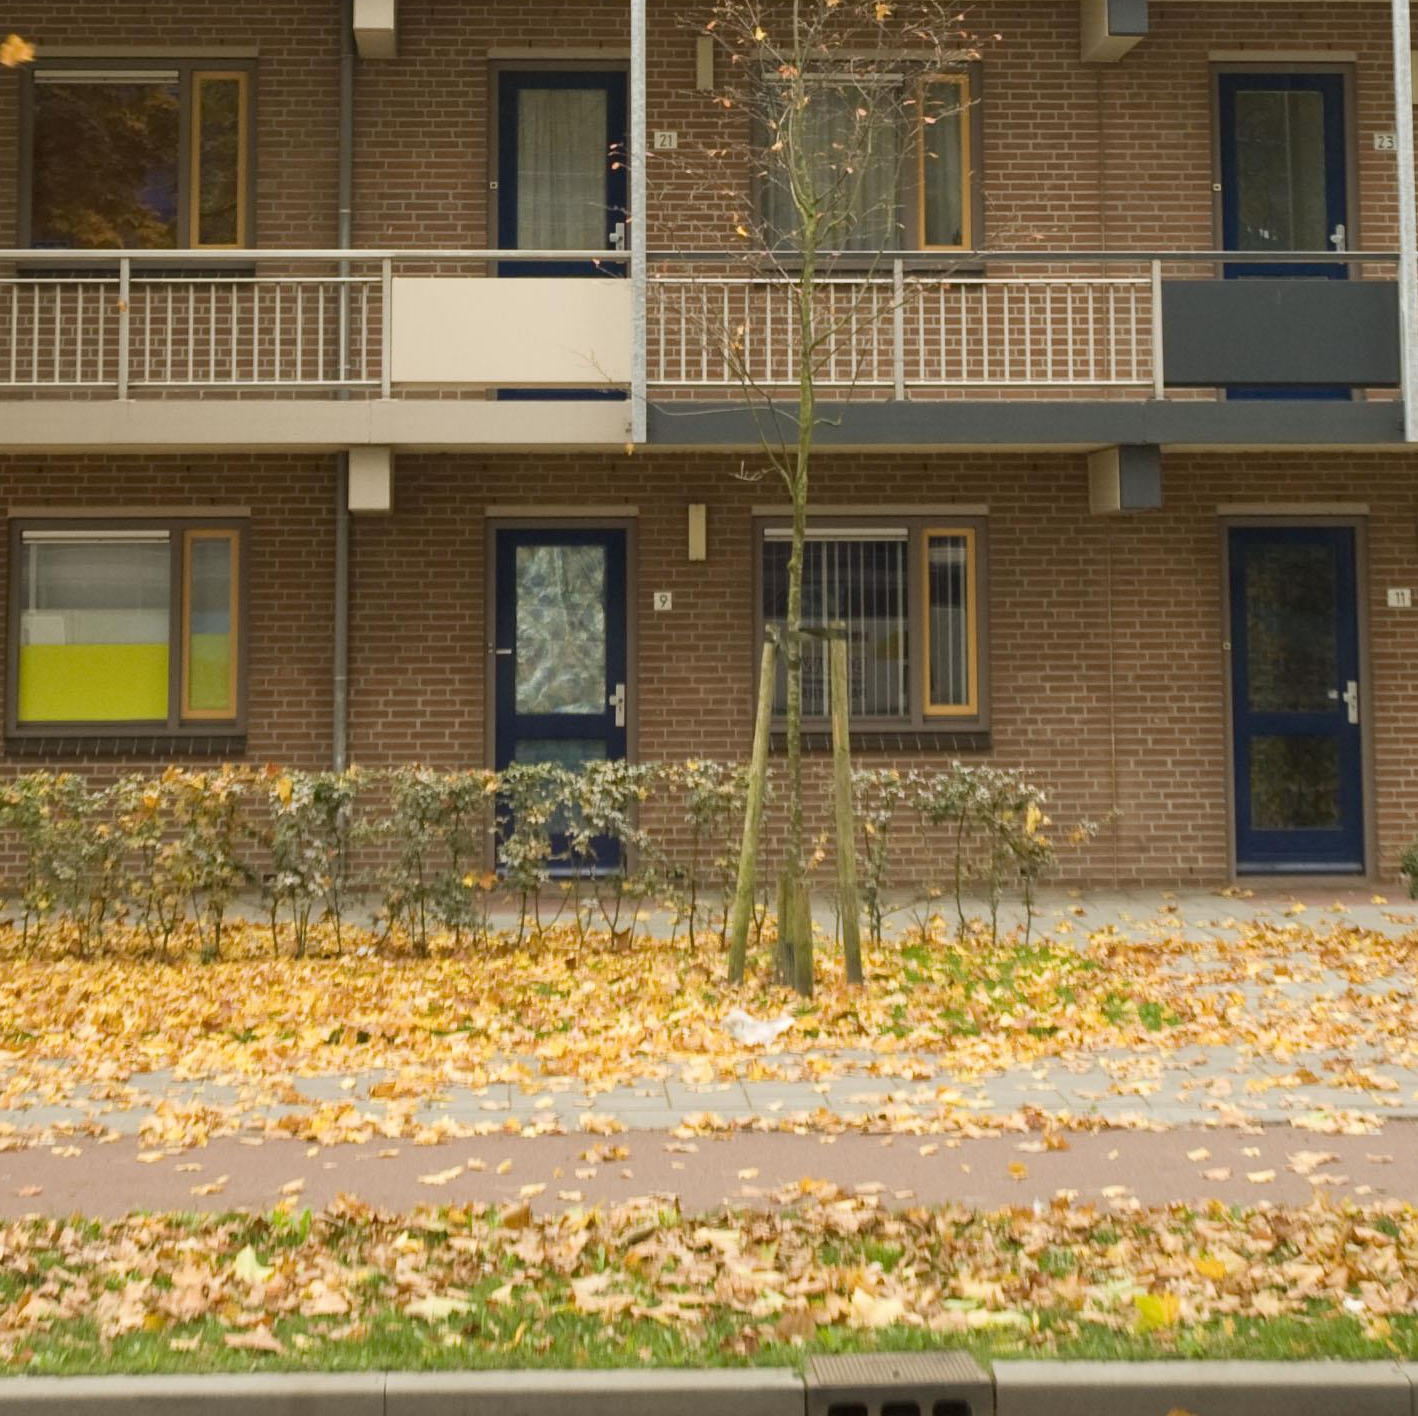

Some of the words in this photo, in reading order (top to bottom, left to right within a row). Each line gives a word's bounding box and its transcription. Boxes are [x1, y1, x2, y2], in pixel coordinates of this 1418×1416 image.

[660, 134, 672, 147] 21
[1378, 135, 1394, 149] 23
[659, 594, 668, 607] 9
[1395, 591, 1406, 604] 11
